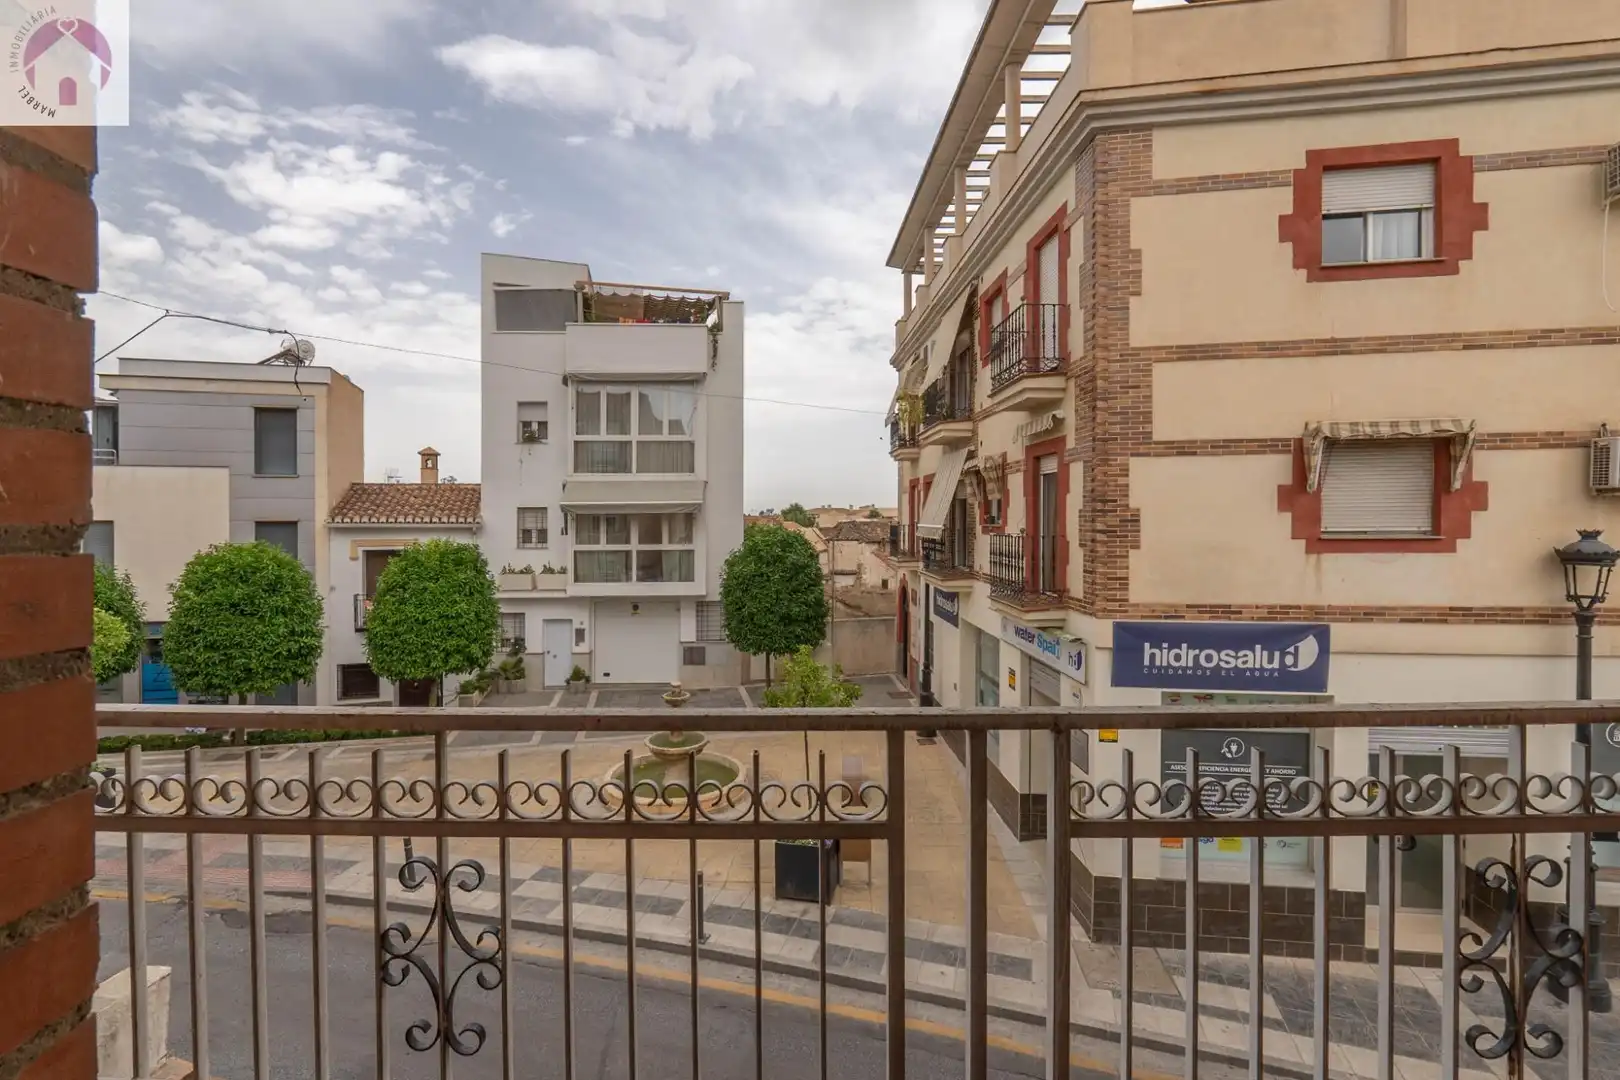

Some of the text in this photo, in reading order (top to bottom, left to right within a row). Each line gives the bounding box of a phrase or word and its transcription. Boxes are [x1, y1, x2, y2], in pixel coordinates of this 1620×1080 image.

[1014, 625, 1035, 645] water
[1143, 668, 1211, 676] CUIDAMOS
[1221, 669, 1235, 677] EL
[1271, 768, 1297, 776] AHORRO
